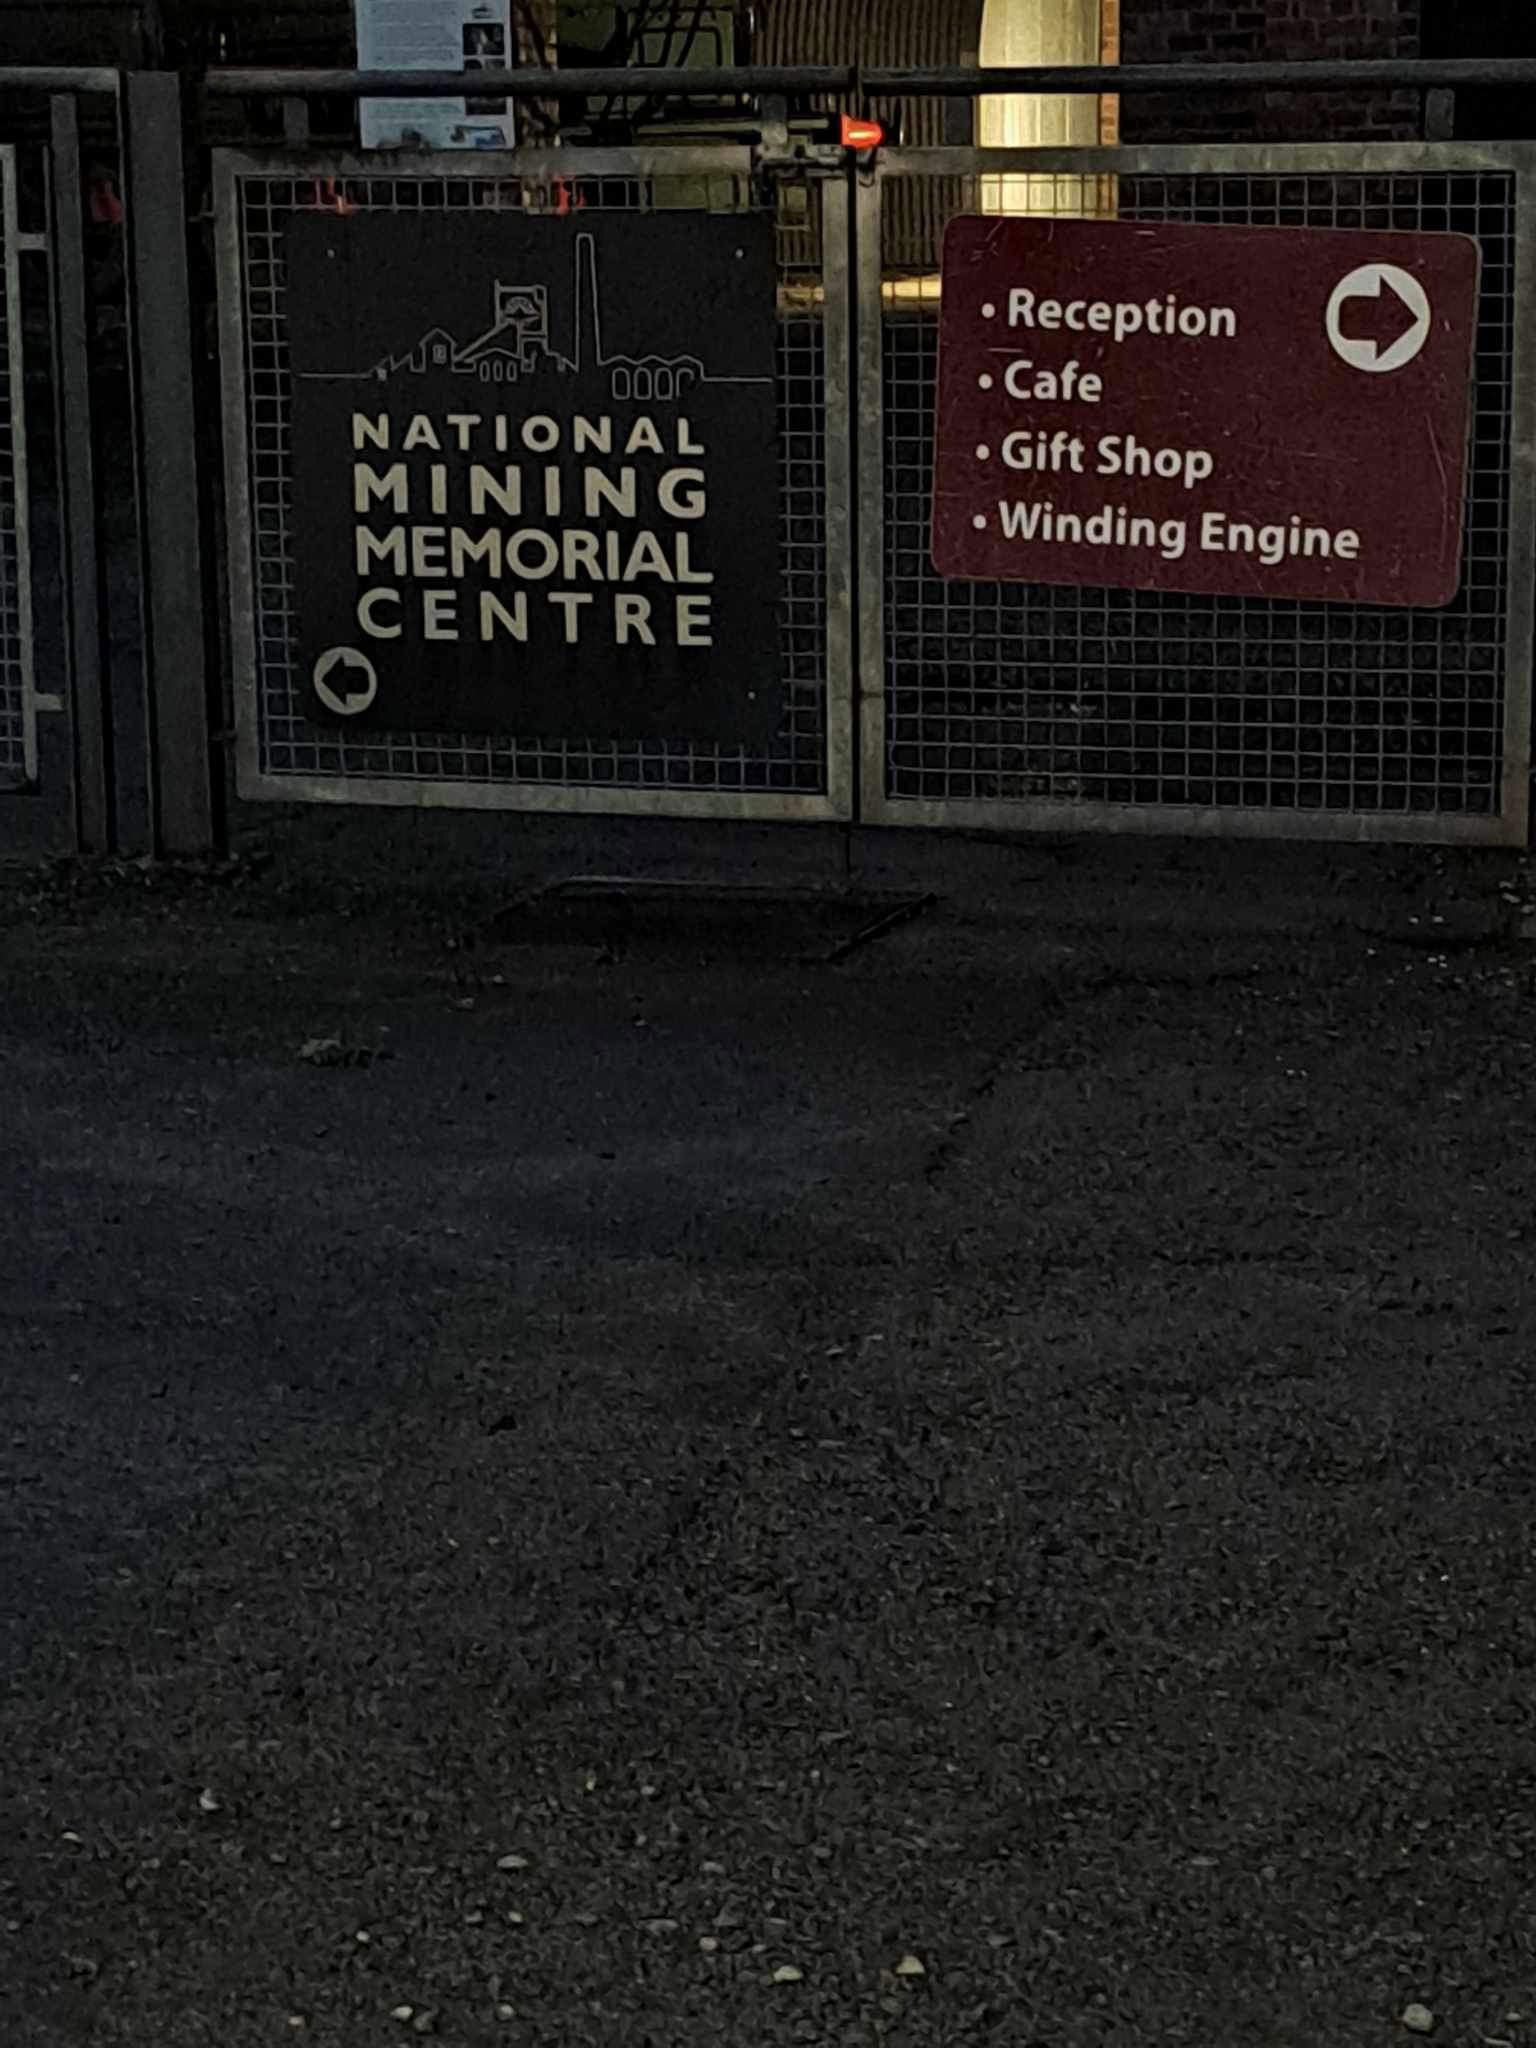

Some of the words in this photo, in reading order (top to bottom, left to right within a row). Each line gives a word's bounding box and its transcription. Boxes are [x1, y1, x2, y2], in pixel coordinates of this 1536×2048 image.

[1008, 288, 1236, 342] Reception
[1004, 359, 1102, 402] Cafe
[353, 413, 705, 455] NATIONAL
[1001, 431, 1085, 473] Gift
[1097, 434, 1213, 489] Shop
[354, 463, 706, 518] MINING
[356, 525, 714, 583] MEMORIAL
[998, 500, 1187, 559] Winding
[1201, 512, 1360, 565] Engine
[357, 587, 713, 646] CENTRE
